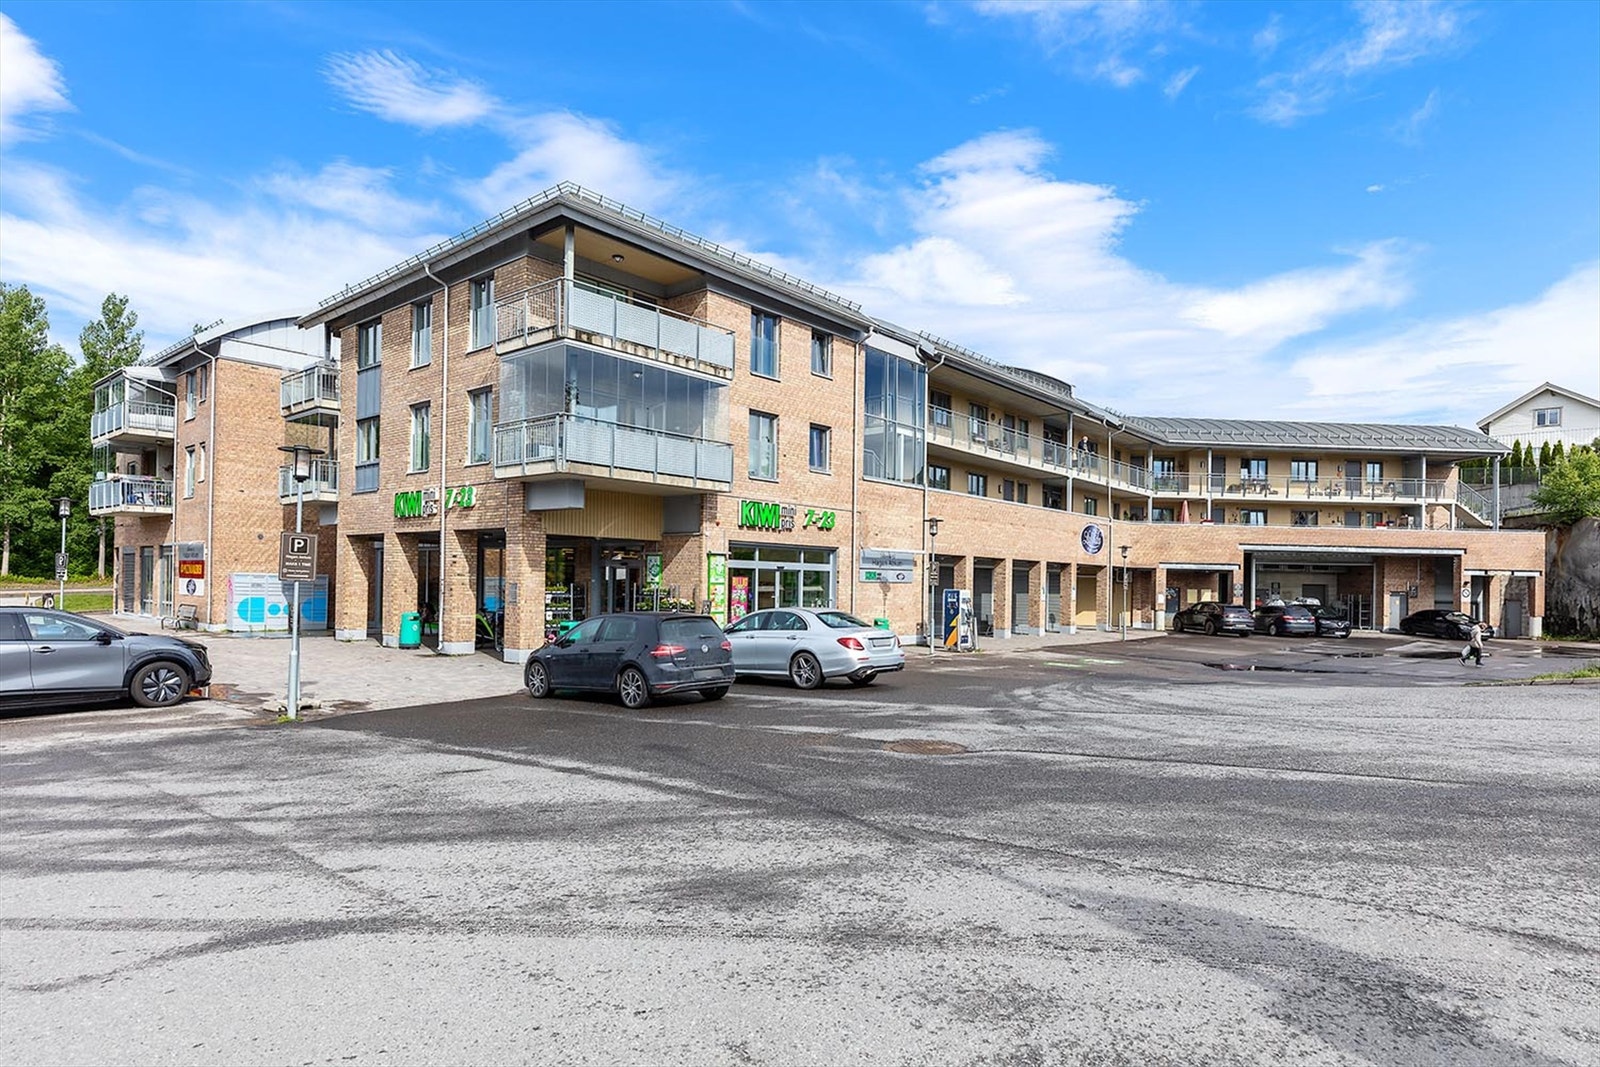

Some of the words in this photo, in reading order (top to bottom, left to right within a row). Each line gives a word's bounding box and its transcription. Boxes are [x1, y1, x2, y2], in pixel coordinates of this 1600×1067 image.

[395, 490, 423, 518] KIWI
[445, 486, 476, 509] 7-23
[740, 500, 780, 528] KIWI
[781, 504, 797, 516] mini
[804, 508, 836, 529] 7-23
[781, 519, 796, 531] pris
[294, 539, 304, 552] P
